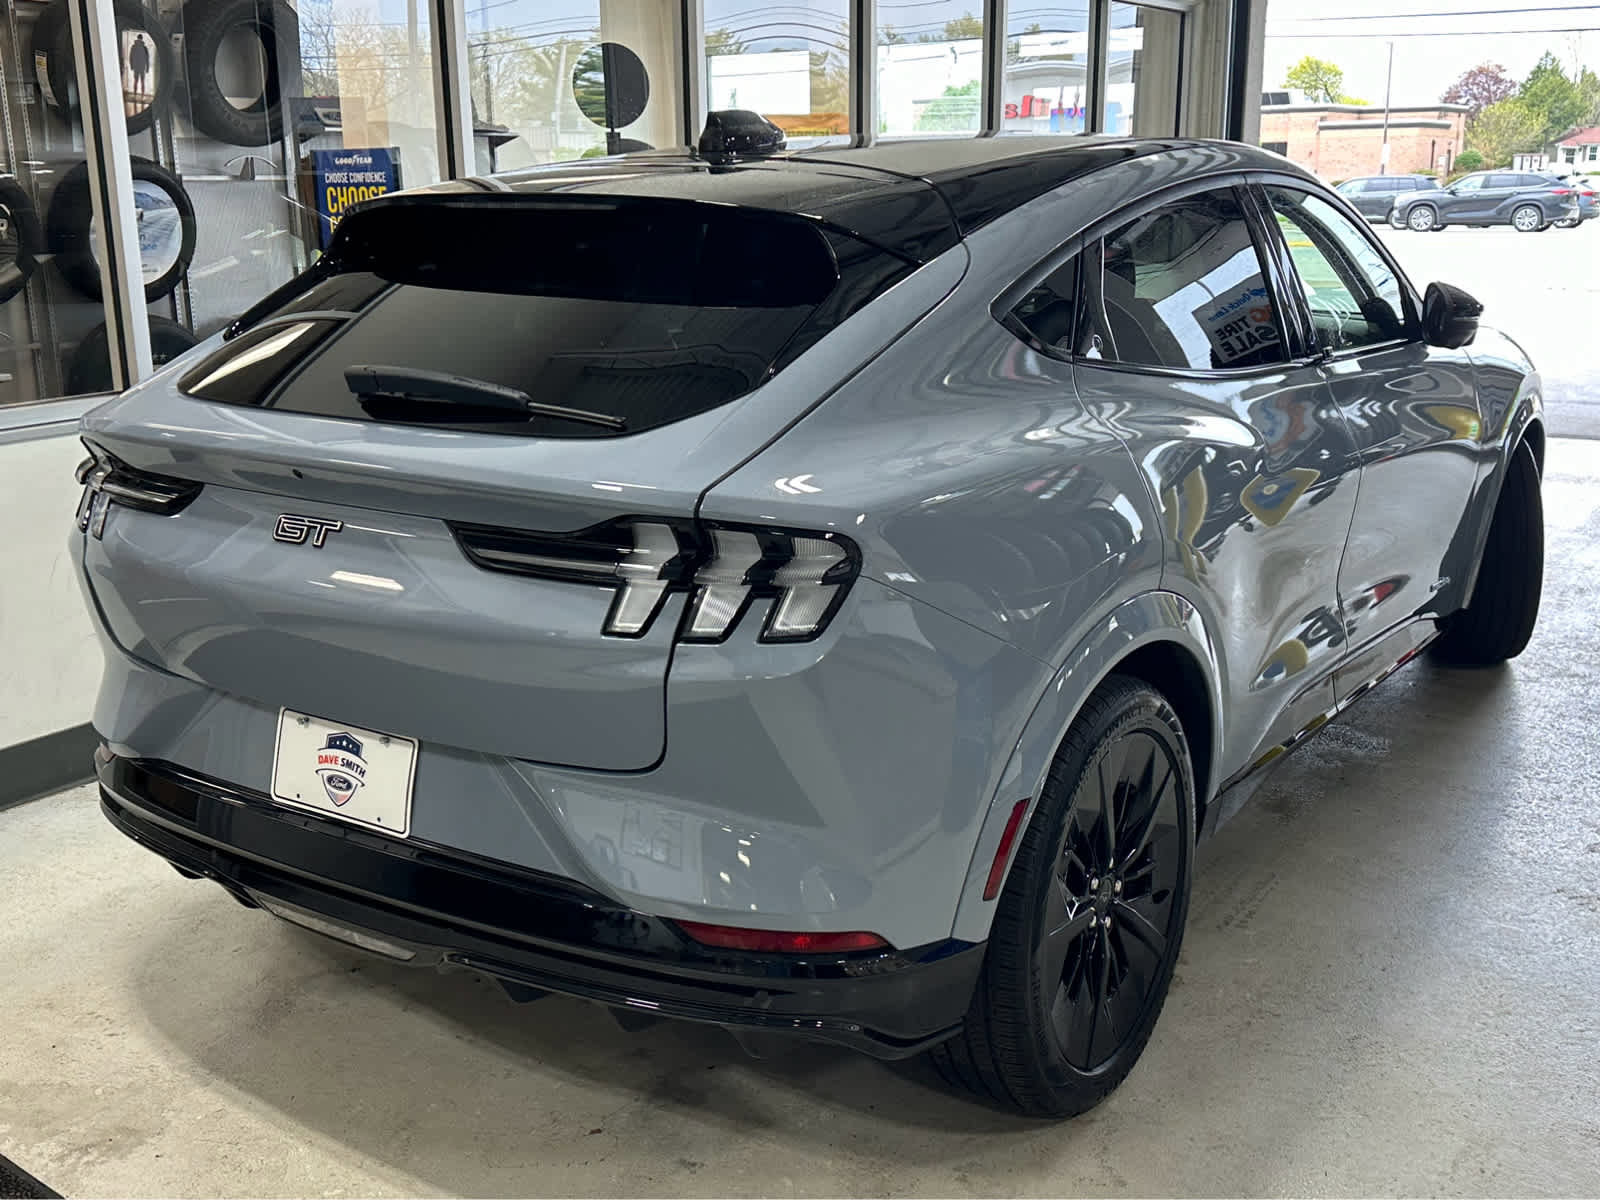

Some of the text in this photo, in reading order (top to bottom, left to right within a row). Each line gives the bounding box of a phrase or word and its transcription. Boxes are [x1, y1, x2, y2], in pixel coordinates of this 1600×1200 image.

[335, 154, 373, 166] GOODYEAR
[325, 171, 387, 184] CHOOSE CONFIDENCE
[273, 513, 344, 549] GT
[318, 754, 367, 778] DAVE SMITH
[330, 777, 348, 790] Ford
